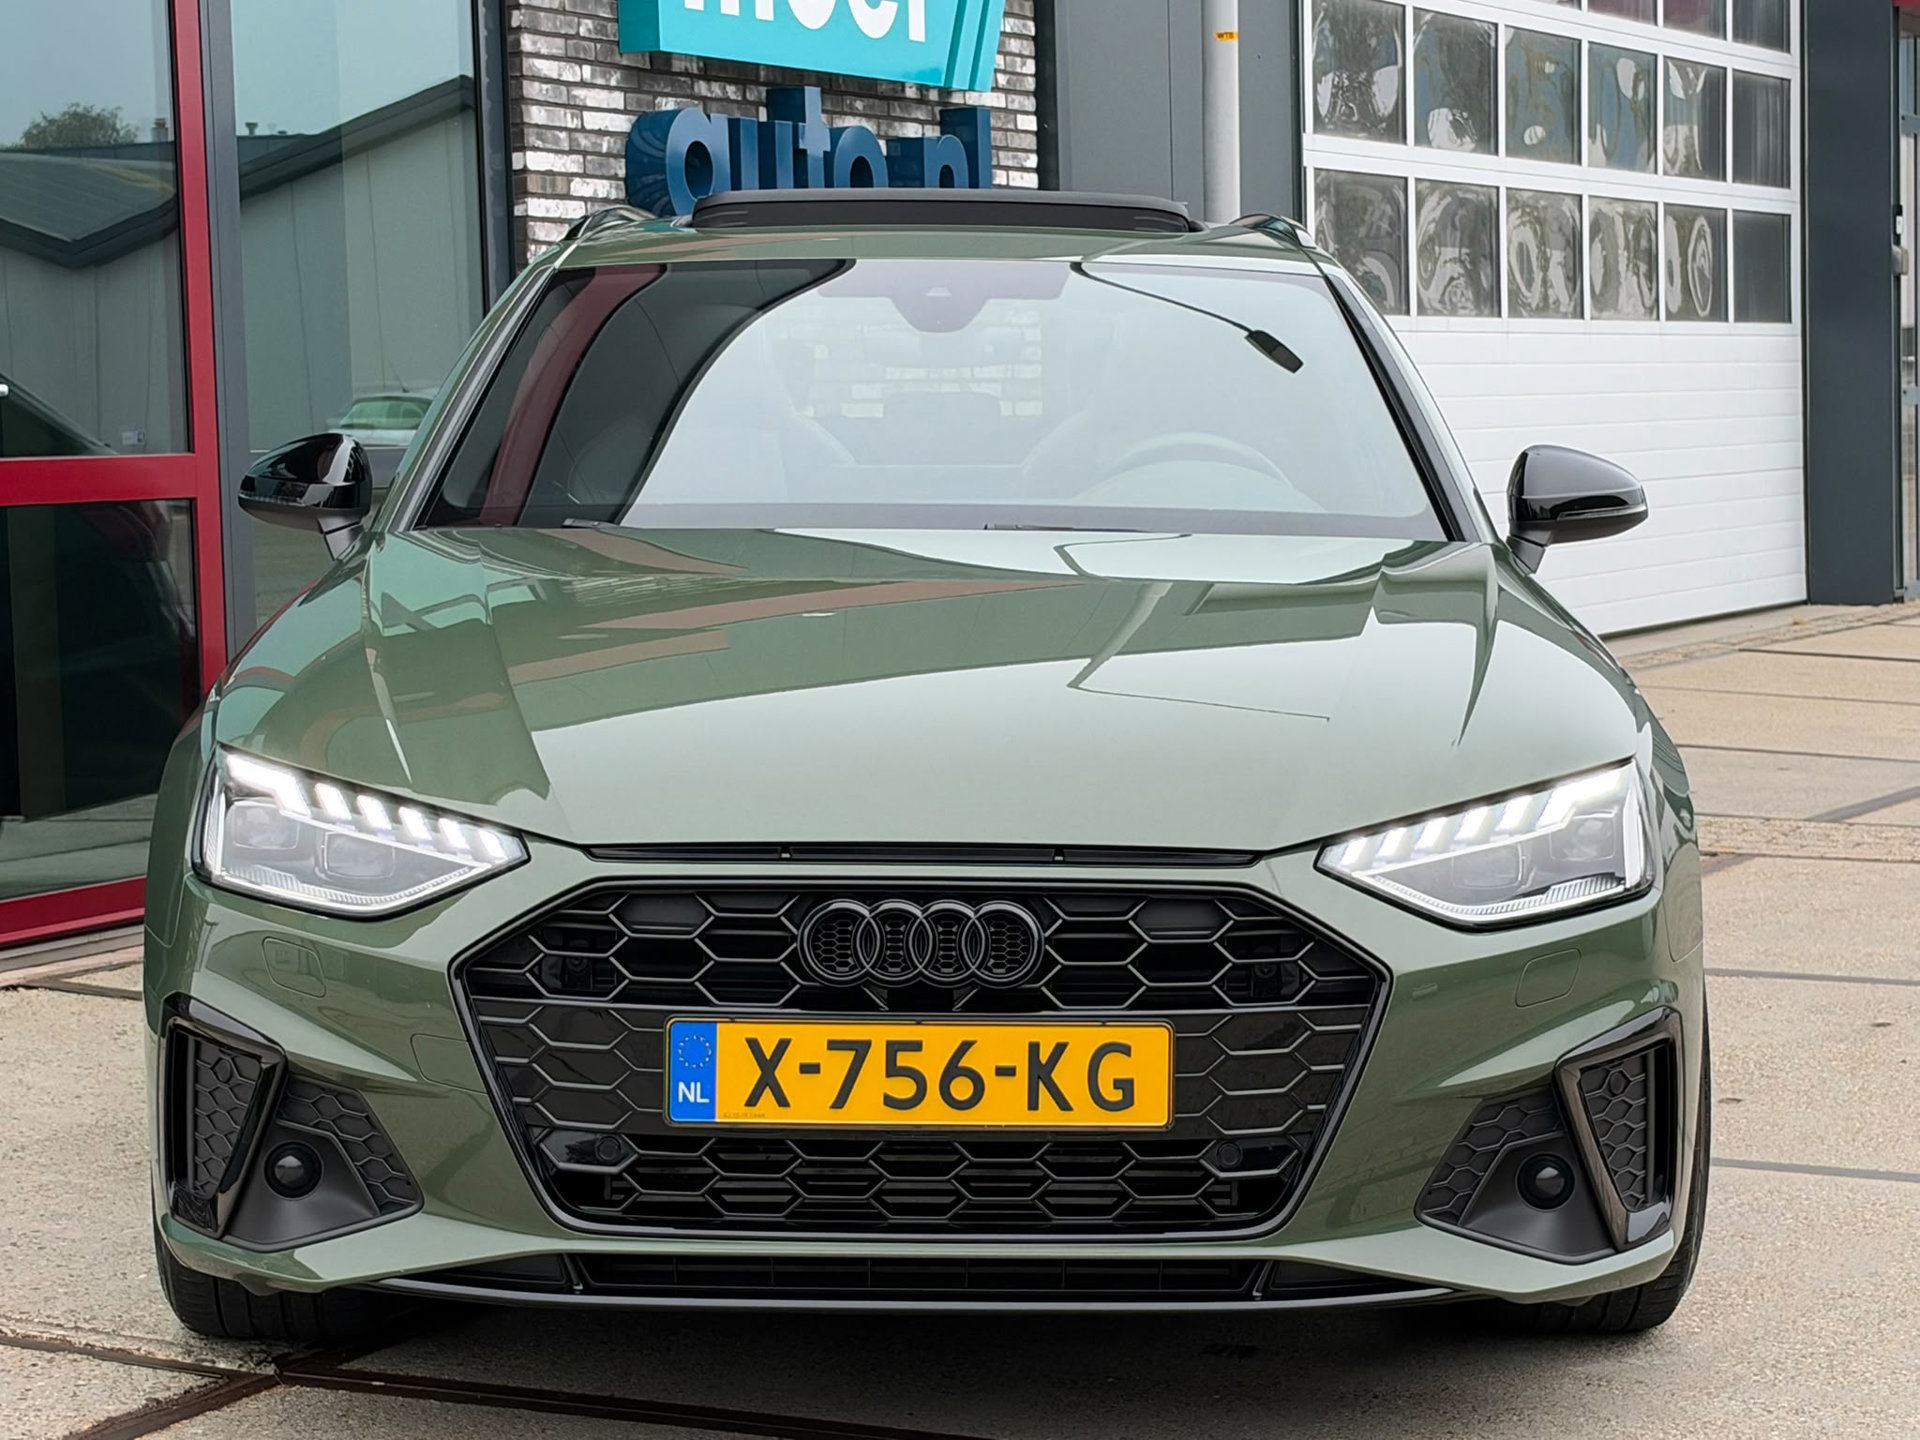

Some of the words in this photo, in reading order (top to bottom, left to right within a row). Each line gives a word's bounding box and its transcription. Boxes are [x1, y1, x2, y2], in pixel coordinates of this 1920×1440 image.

[660, 86, 992, 215] autonl
[678, 1081, 710, 1103] NL
[744, 1037, 1135, 1112] X-756-KG
